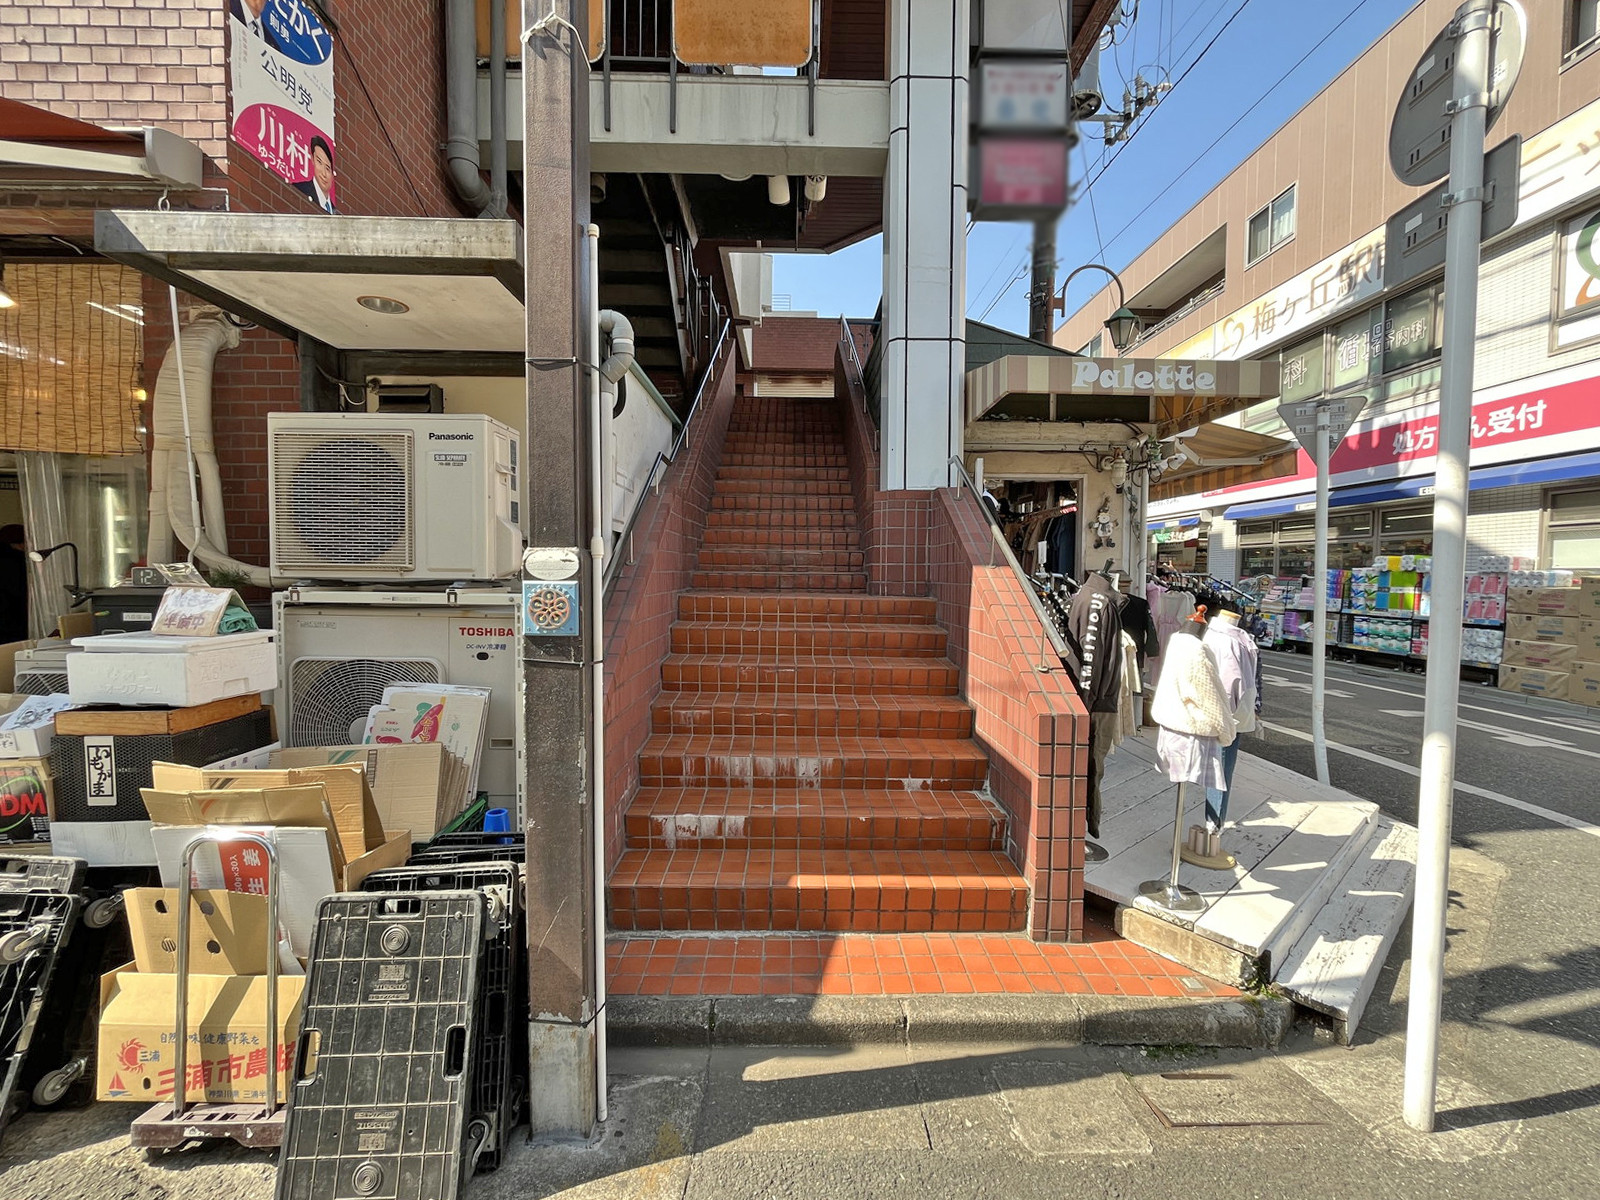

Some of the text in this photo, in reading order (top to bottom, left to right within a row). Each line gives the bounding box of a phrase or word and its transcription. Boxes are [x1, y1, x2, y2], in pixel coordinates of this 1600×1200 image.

[261, 50, 313, 115] 公明党
[257, 106, 312, 178] 川村
[258, 143, 295, 180] ゆうだい
[1071, 361, 1216, 391] Palette
[1283, 355, 1308, 389] 科
[428, 432, 474, 440] Panasonic
[1392, 399, 1547, 456] 処方ん受付
[458, 627, 515, 637] TOSHIBA
[1080, 592, 1105, 690] AMBITIOUS
[242, 848, 266, 896] 生姜
[161, 1032, 200, 1044] 自然味
[139, 1050, 160, 1062] 三浦
